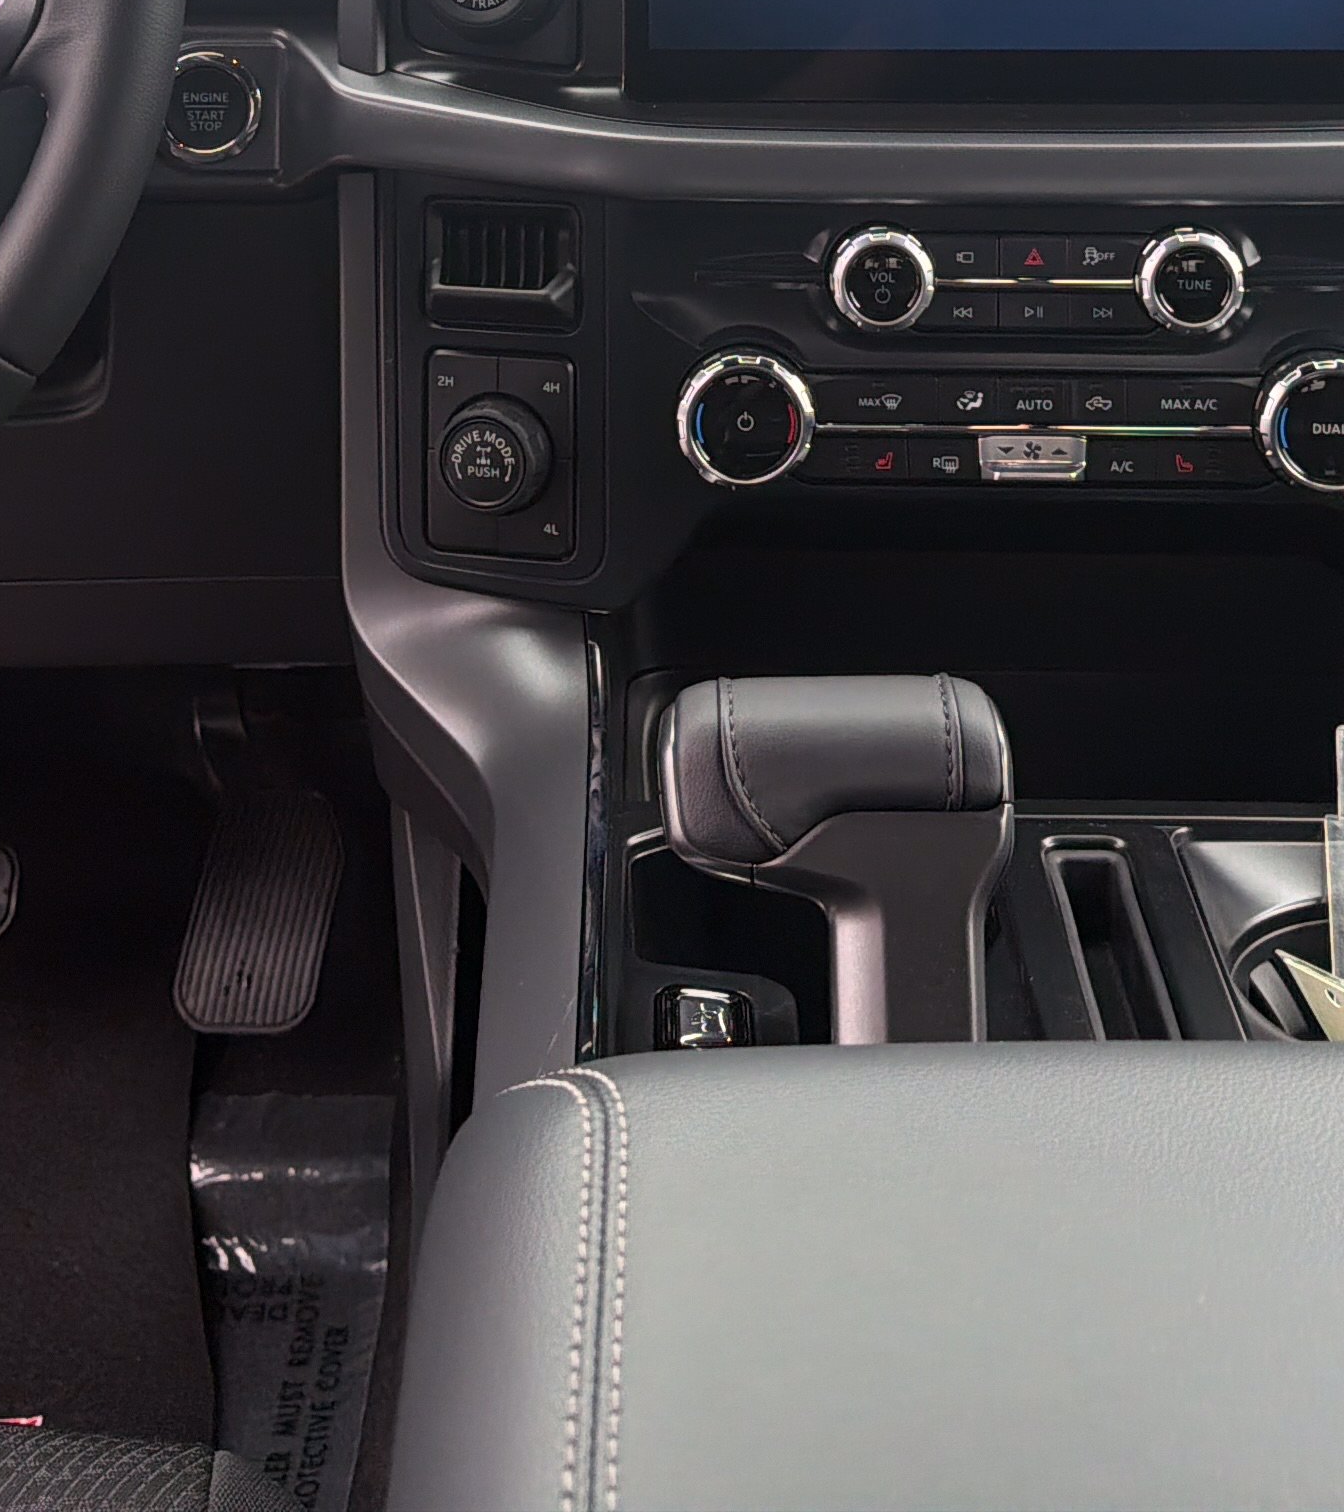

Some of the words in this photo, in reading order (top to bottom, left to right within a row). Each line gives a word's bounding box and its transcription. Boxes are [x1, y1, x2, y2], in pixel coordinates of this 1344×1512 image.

[182, 91, 229, 103] ENGINE
[186, 110, 225, 121] START
[190, 121, 222, 131] STOP
[1096, 252, 1116, 261] OFF
[869, 272, 896, 285] VOL
[1176, 279, 1212, 292] TUNE
[437, 375, 454, 388] 2H
[542, 382, 561, 394] 4H
[858, 397, 881, 407] MAX
[1016, 399, 1054, 411] AUTO
[1160, 398, 1191, 411] MAX
[1194, 398, 1219, 411] A/C
[451, 429, 482, 464] DRIVE
[483, 430, 516, 466] MODE
[467, 465, 500, 478] PUSH
[1110, 460, 1134, 473] A/C
[543, 523, 560, 535] 4L
[272, 1380, 306, 1438] MUST
